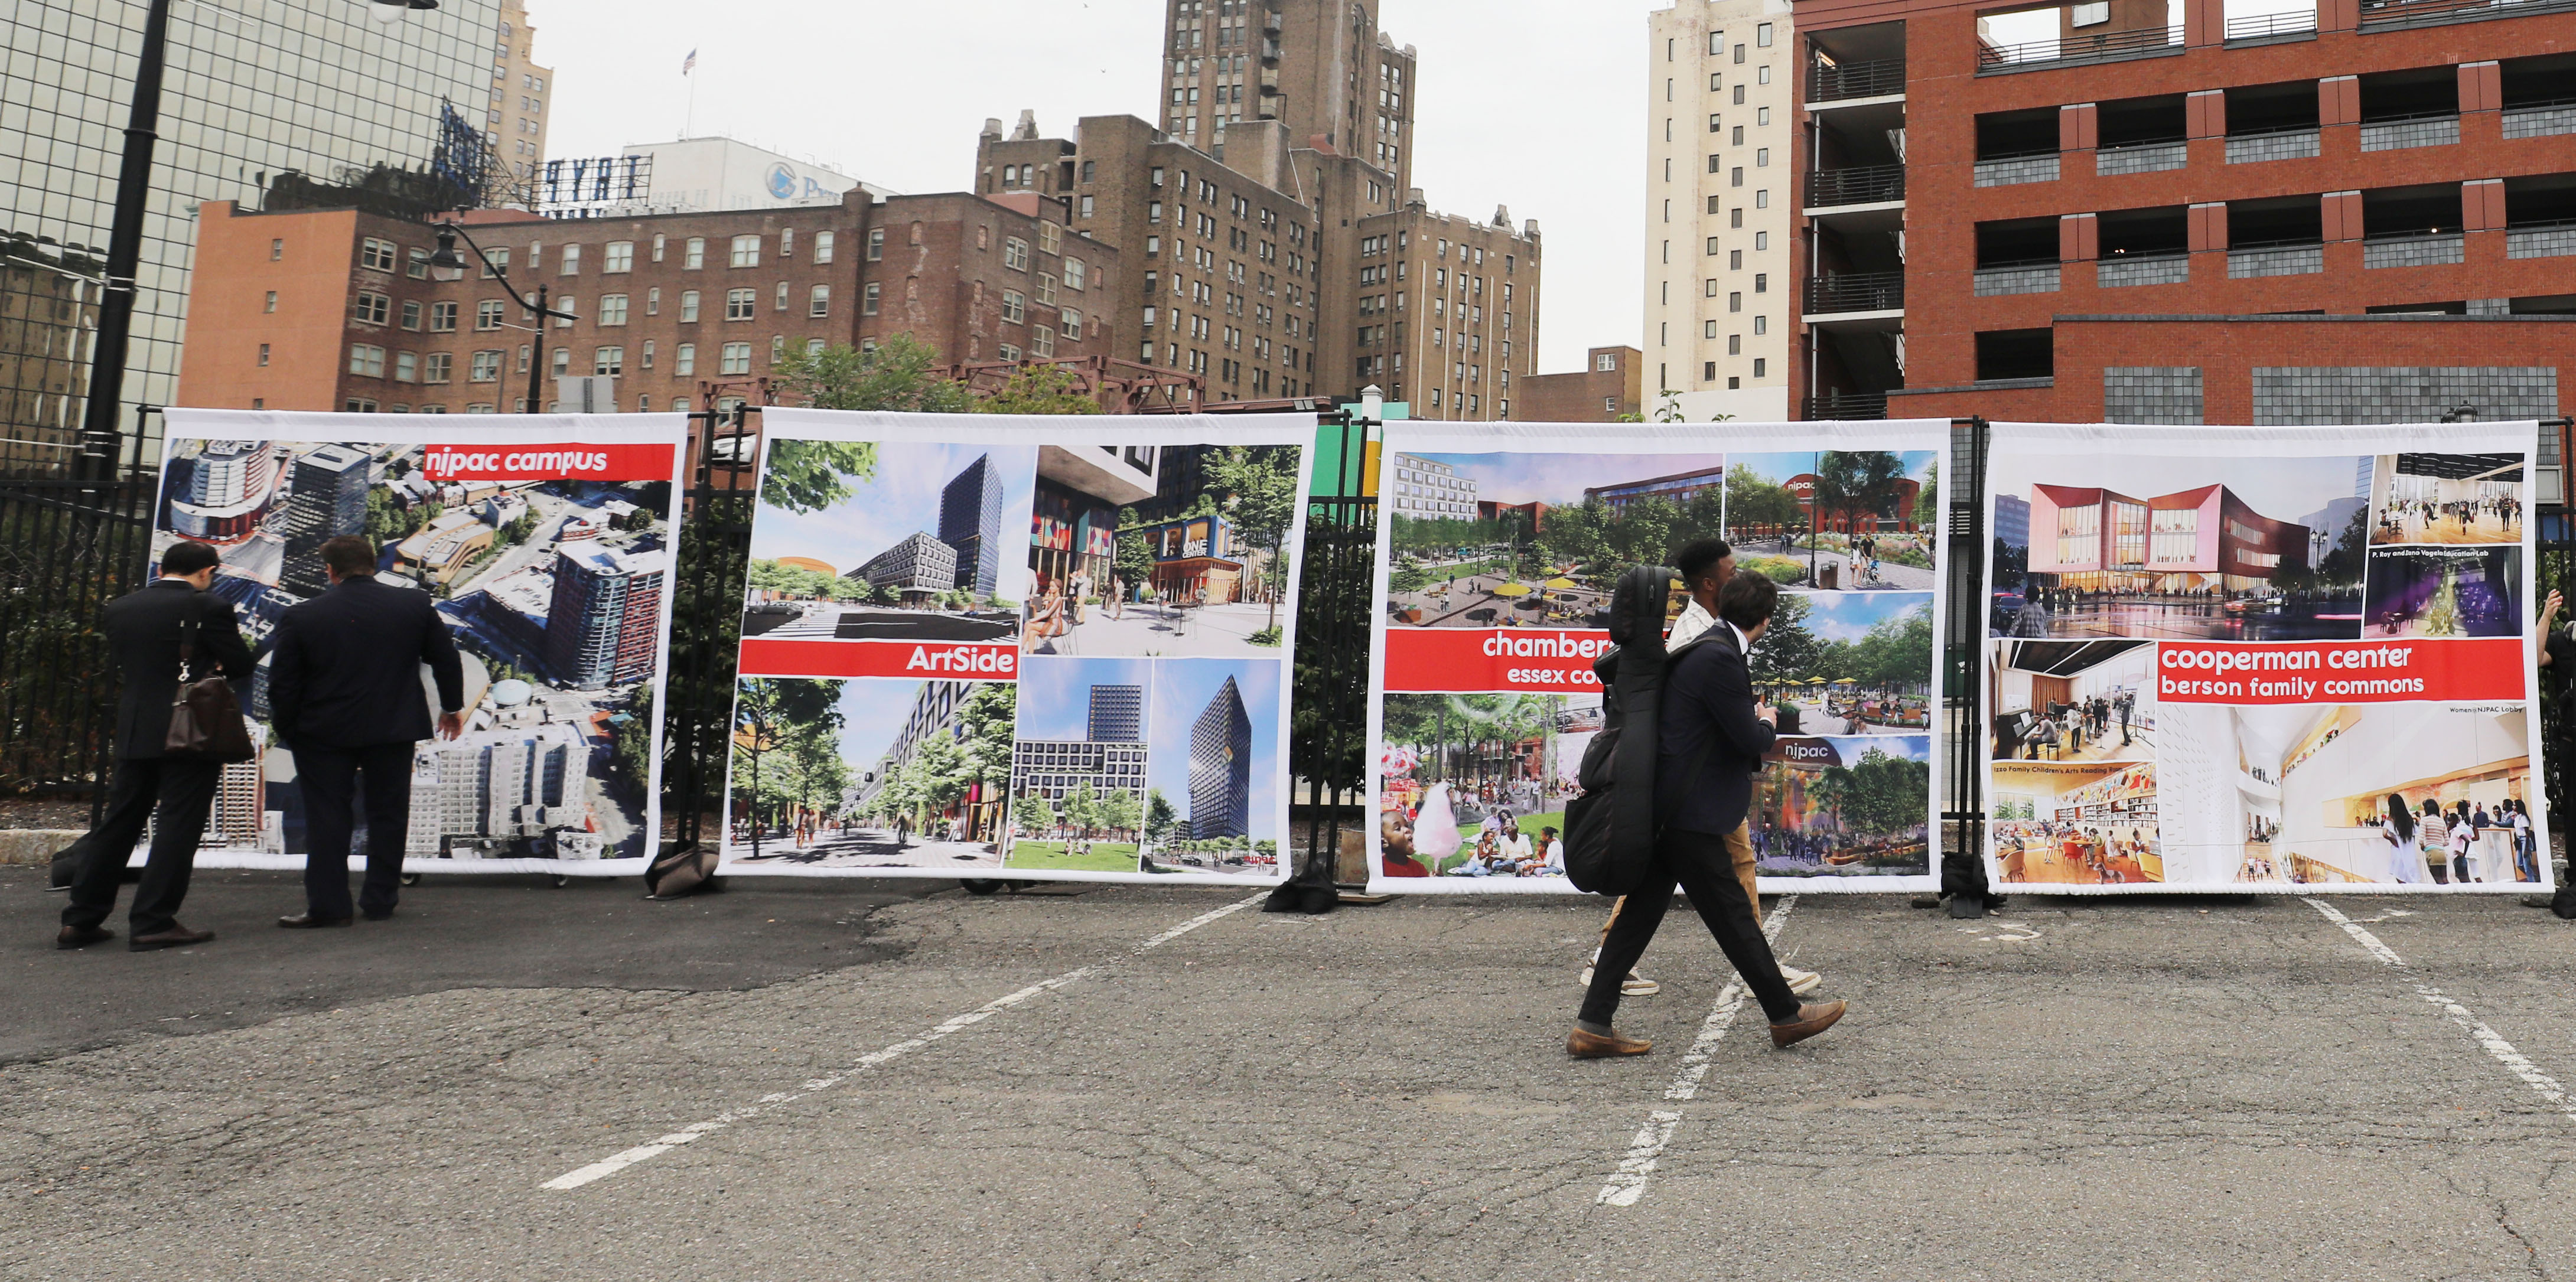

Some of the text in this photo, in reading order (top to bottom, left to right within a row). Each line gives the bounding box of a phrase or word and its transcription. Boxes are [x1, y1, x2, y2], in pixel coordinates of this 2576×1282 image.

[426, 446, 607, 477] njpac campus
[1182, 550, 1206, 559] CENTER
[1183, 539, 1207, 552] ONE
[906, 645, 1014, 672] ArtSide
[2161, 644, 2412, 676] cooperman center
[1507, 668, 1603, 685] essex co
[2161, 676, 2425, 699] berson family commons
[1785, 742, 1828, 760] njpac
